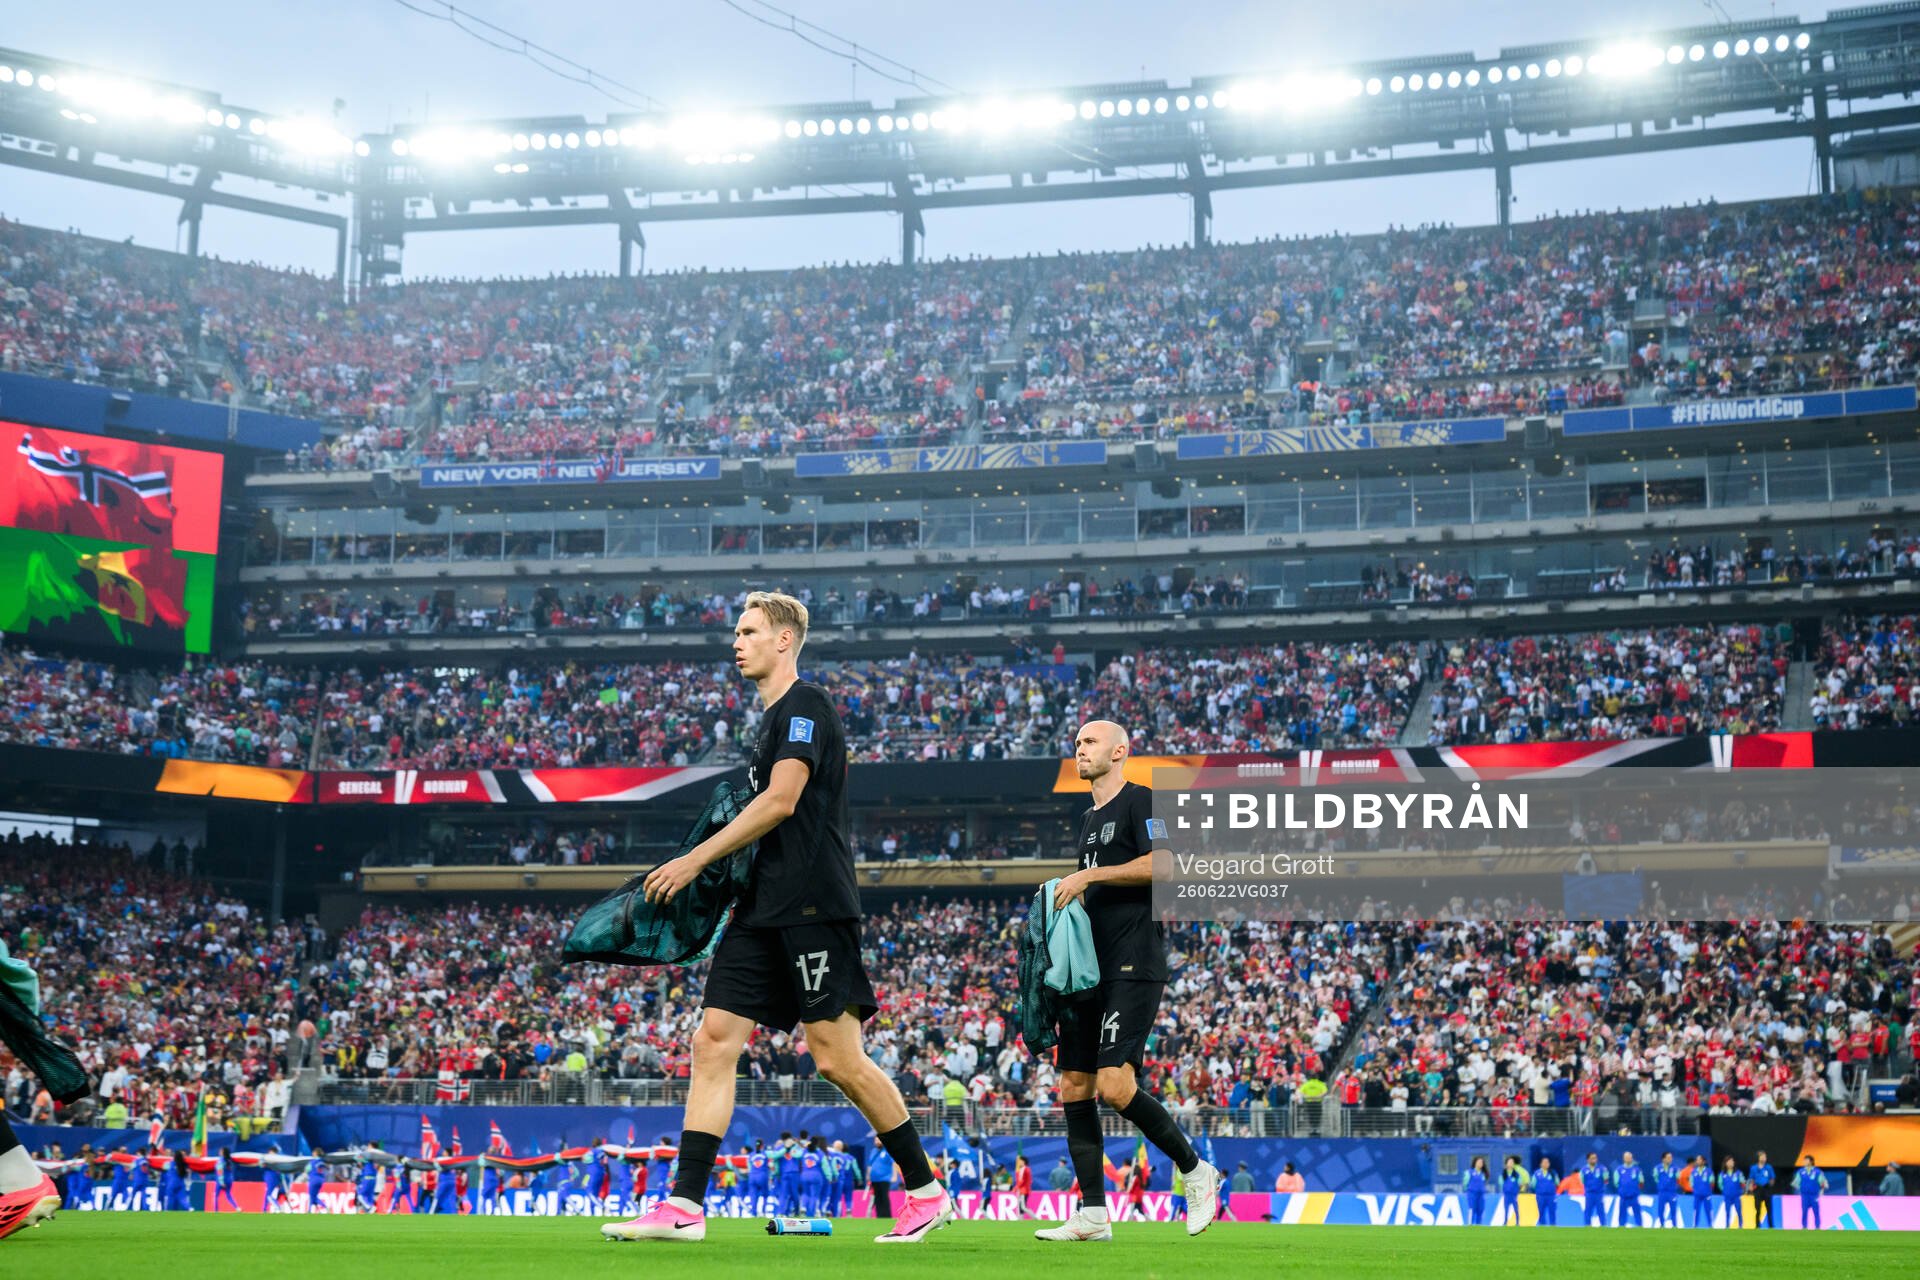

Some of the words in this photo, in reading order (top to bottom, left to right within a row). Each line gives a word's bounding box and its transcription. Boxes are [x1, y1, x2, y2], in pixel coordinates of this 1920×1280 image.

[1671, 399, 1804, 424] #FIFAWorldCup
[433, 468, 484, 482] NEW
[491, 465, 539, 480] YOR
[1237, 762, 1286, 778] SENEGAL
[1331, 758, 1380, 775] NORWAY
[338, 781, 383, 795] SENEGAL
[423, 780, 468, 793] NORWAY
[796, 950, 830, 992] 17
[948, 1193, 1020, 1221] TAR
[1035, 1194, 1183, 1222] AIWYS
[1356, 1194, 1465, 1226] VISA
